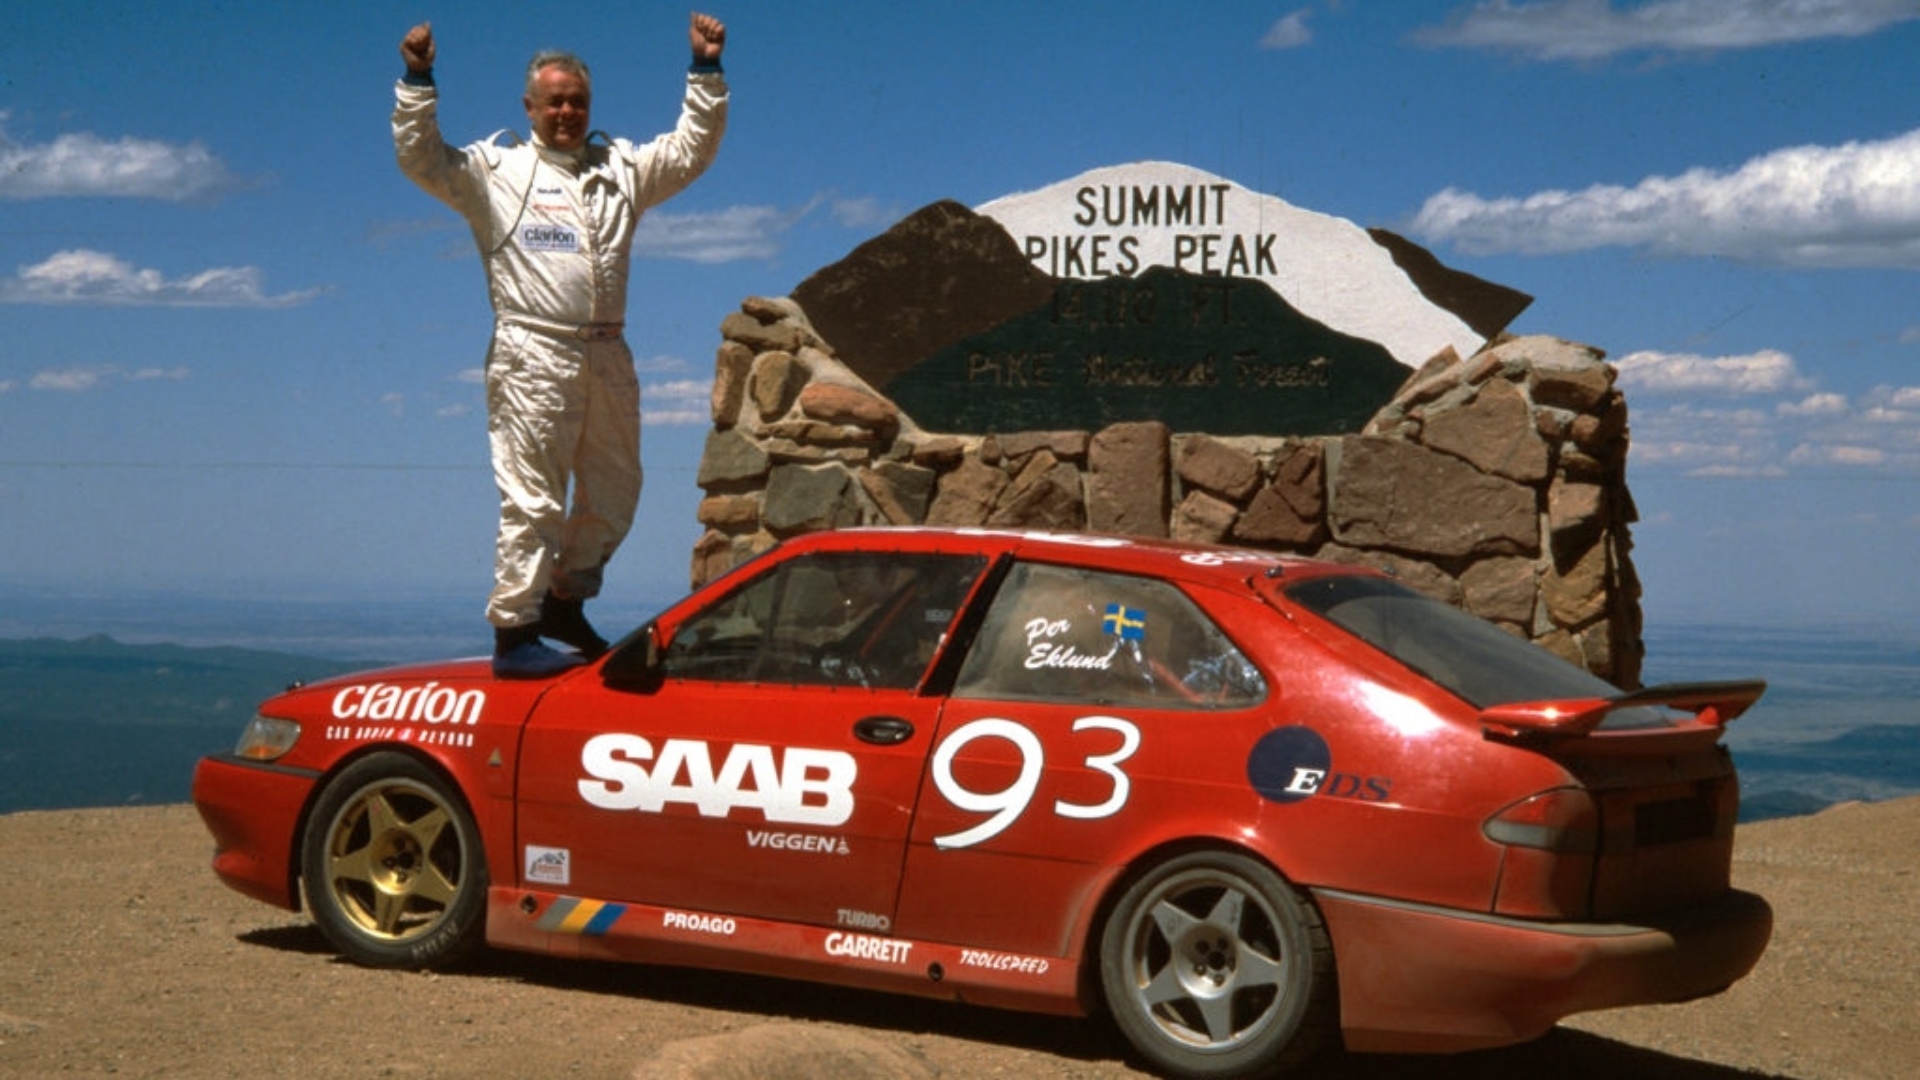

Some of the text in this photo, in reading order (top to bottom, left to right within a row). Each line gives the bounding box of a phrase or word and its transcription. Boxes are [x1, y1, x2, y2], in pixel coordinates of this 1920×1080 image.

[1073, 184, 1231, 227] SUMMIT
[1025, 233, 1278, 277] PIKES PEAK
[967, 352, 1055, 387] PIKE
[1025, 617, 1071, 646] Per
[1024, 642, 1117, 670] Eklund
[332, 681, 486, 725] clarion
[326, 725, 350, 739] CAR
[577, 732, 857, 827] SAAB
[931, 716, 1141, 849] 93
[1284, 767, 1391, 800] EDS
[746, 831, 836, 853] VIGGEN
[663, 912, 736, 935] PROAGO
[837, 909, 890, 931] TURBO
[825, 932, 912, 964] GARRETT
[960, 950, 1049, 974] TROLLSPEED
